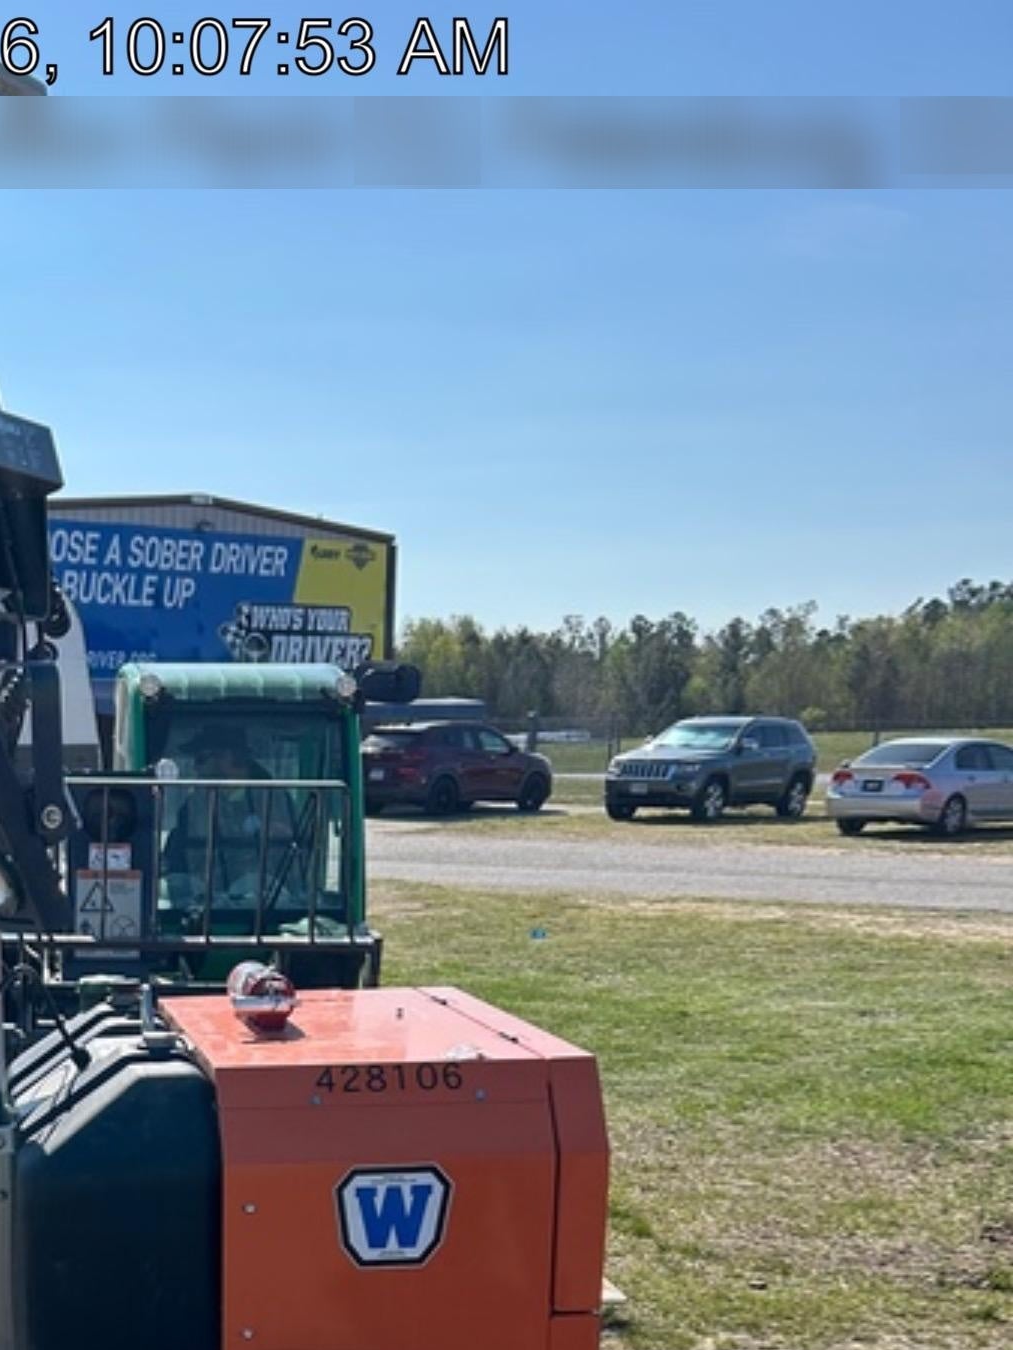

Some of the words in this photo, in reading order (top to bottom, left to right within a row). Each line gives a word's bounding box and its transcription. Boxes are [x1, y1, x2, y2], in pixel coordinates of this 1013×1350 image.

[104, 534, 122, 566] A
[128, 535, 204, 572] SOBER
[209, 541, 289, 577] DRIVER
[163, 576, 196, 609] UP
[307, 607, 349, 632] YOUR
[315, 1062, 464, 1092] 428106
[355, 1184, 433, 1249] W
